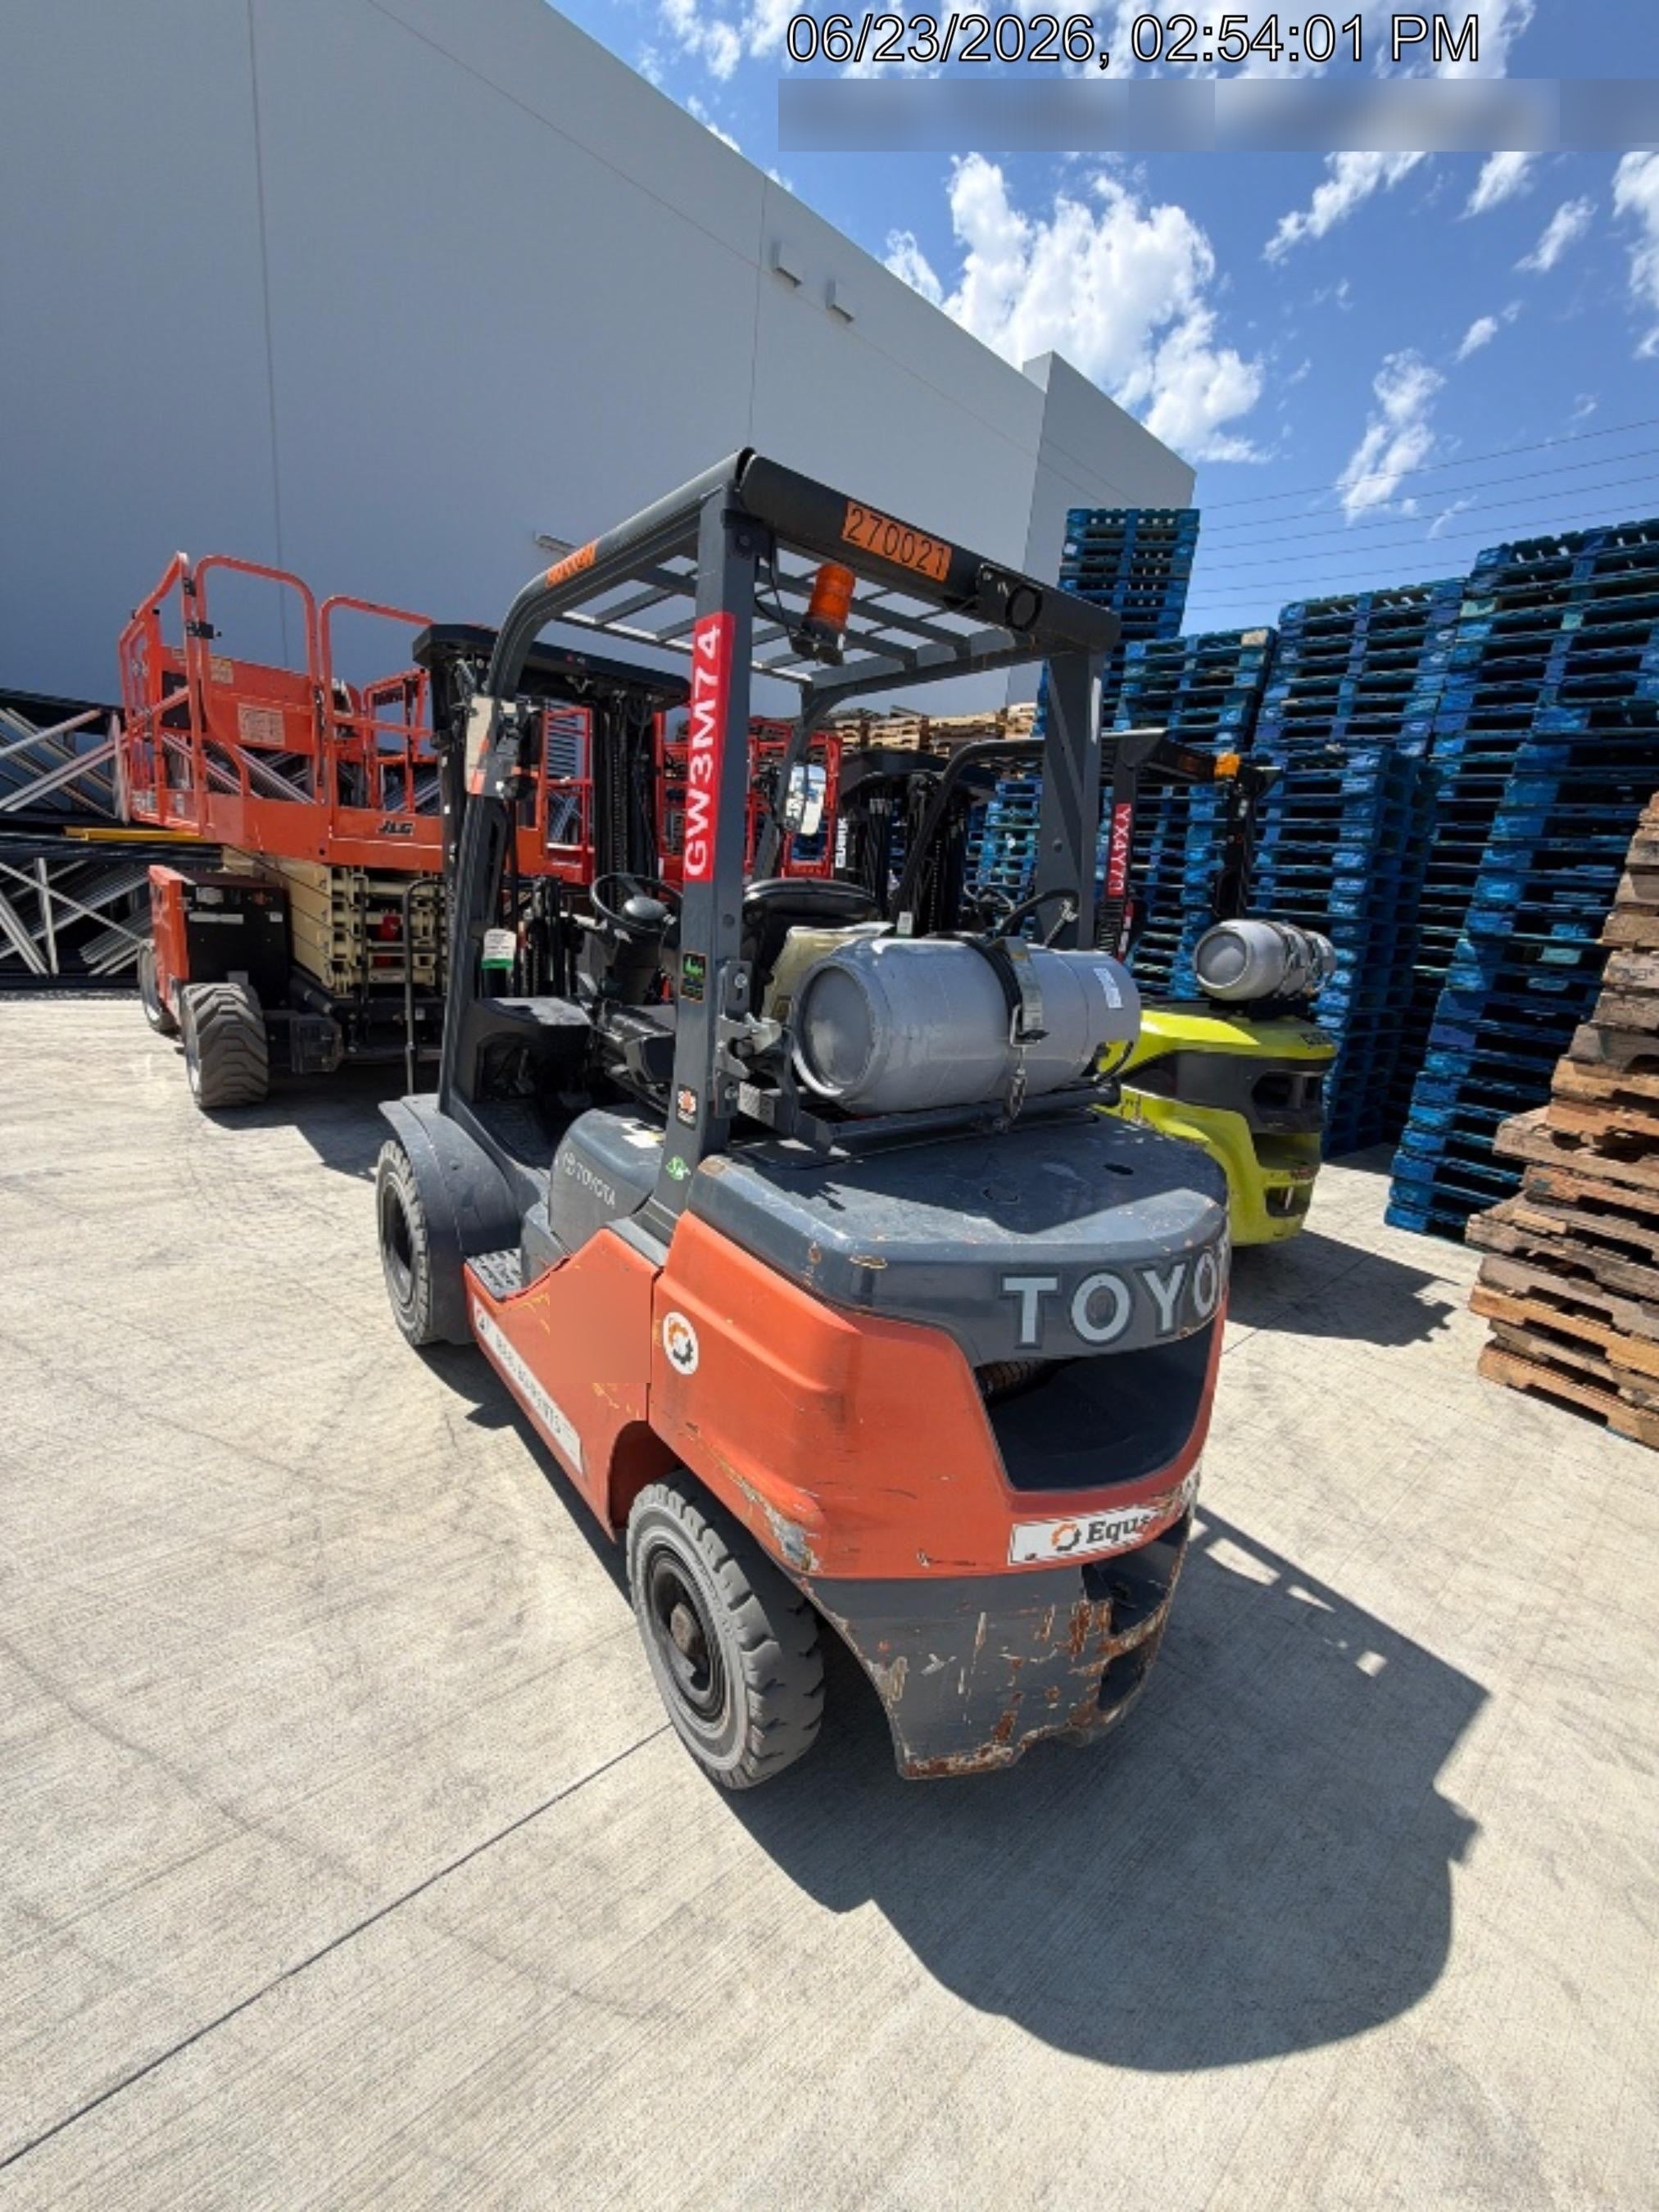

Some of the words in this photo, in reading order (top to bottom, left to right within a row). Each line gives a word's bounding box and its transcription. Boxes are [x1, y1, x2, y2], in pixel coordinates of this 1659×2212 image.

[846, 507, 945, 575] 270021
[685, 623, 721, 876] GW3M74
[1003, 1249, 1224, 1343] TOYO
[1086, 1515, 1151, 1544] Equ
